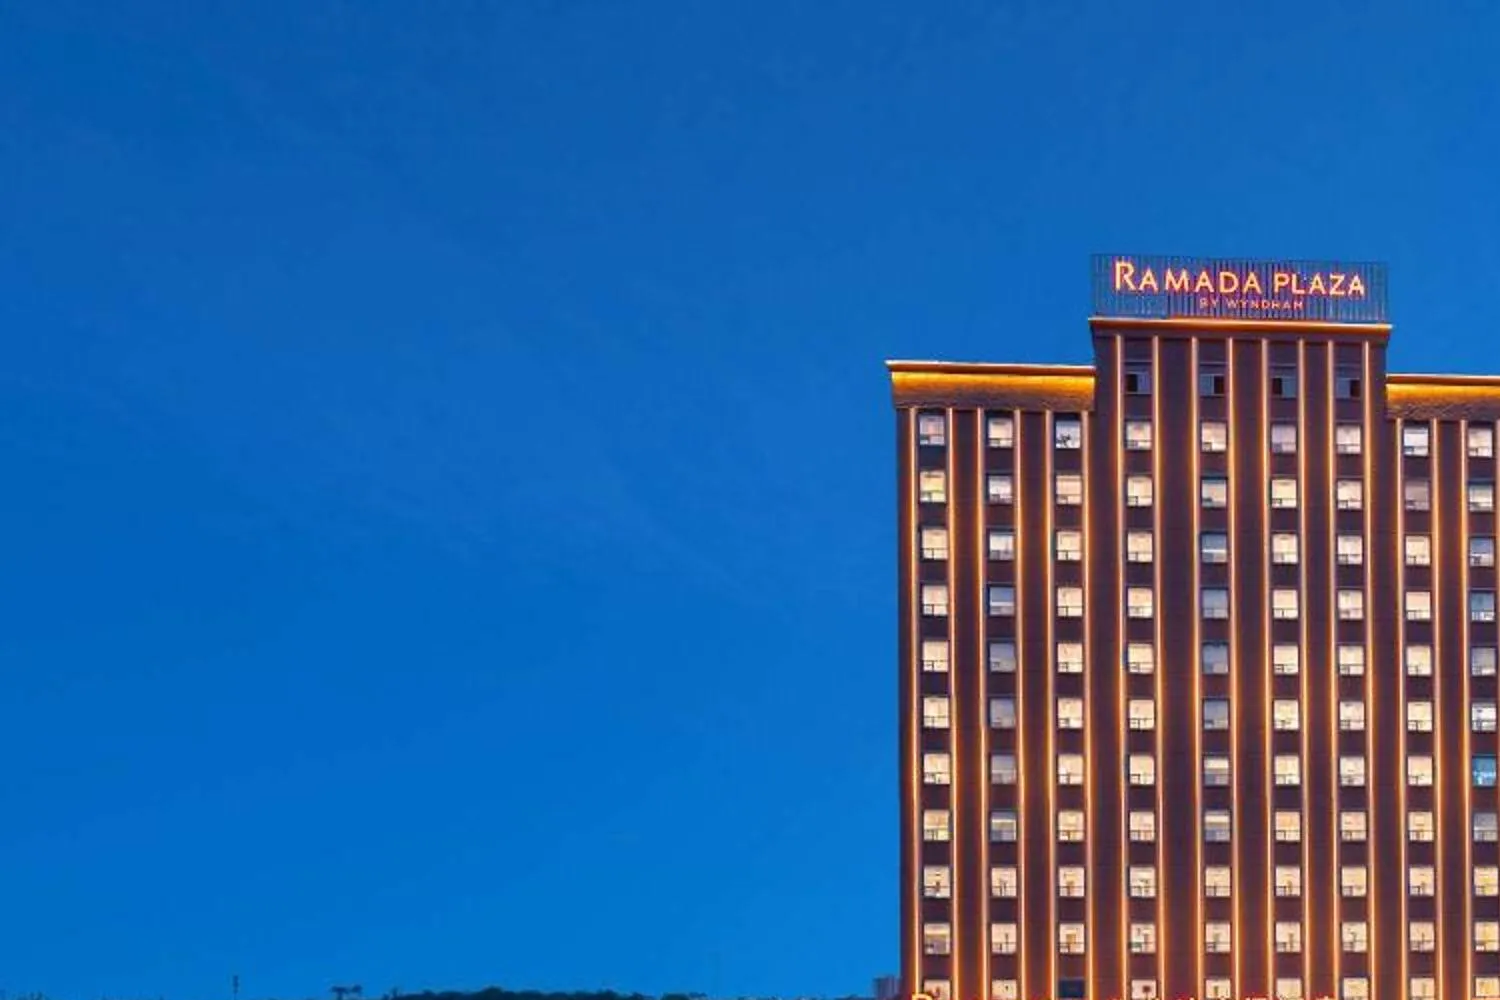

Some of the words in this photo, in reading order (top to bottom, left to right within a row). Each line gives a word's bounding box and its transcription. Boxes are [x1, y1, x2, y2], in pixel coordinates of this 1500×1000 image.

[1113, 260, 1262, 293] RAMADA
[1273, 272, 1365, 295] PLAZA
[1199, 297, 1218, 308] BY
